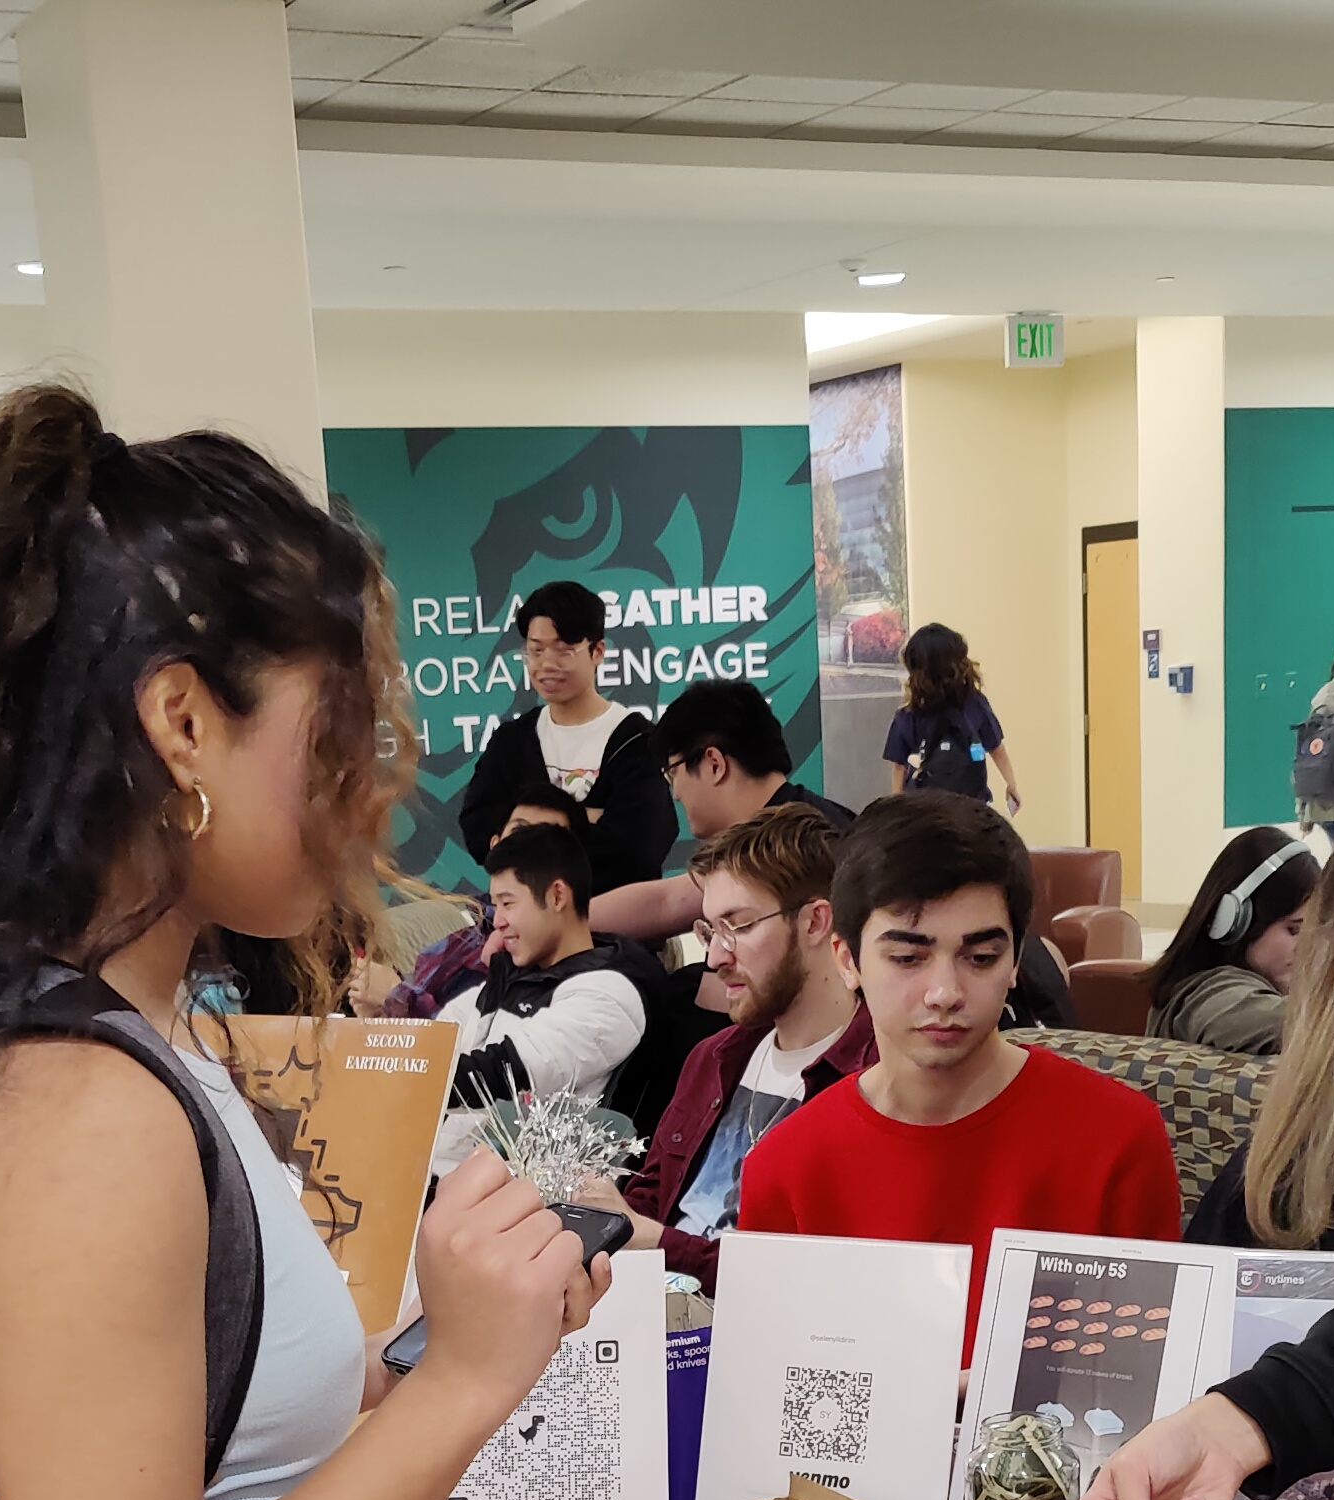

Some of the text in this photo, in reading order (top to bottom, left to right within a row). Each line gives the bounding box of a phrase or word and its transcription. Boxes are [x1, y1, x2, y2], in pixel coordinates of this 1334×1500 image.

[1017, 323, 1054, 359] EXIT
[412, 585, 769, 636] RELA GATHER
[597, 641, 769, 687] ENGAGE
[365, 1033, 415, 1049] SECOND
[345, 1055, 429, 1074] EARTHQUAKE
[1040, 1256, 1128, 1280] With only 5$
[1265, 1274, 1305, 1289] nytimes
[666, 1335, 701, 1348] emium
[666, 1350, 682, 1359] ks,
[676, 1357, 707, 1370] knives
[790, 1471, 850, 1489] nmo
